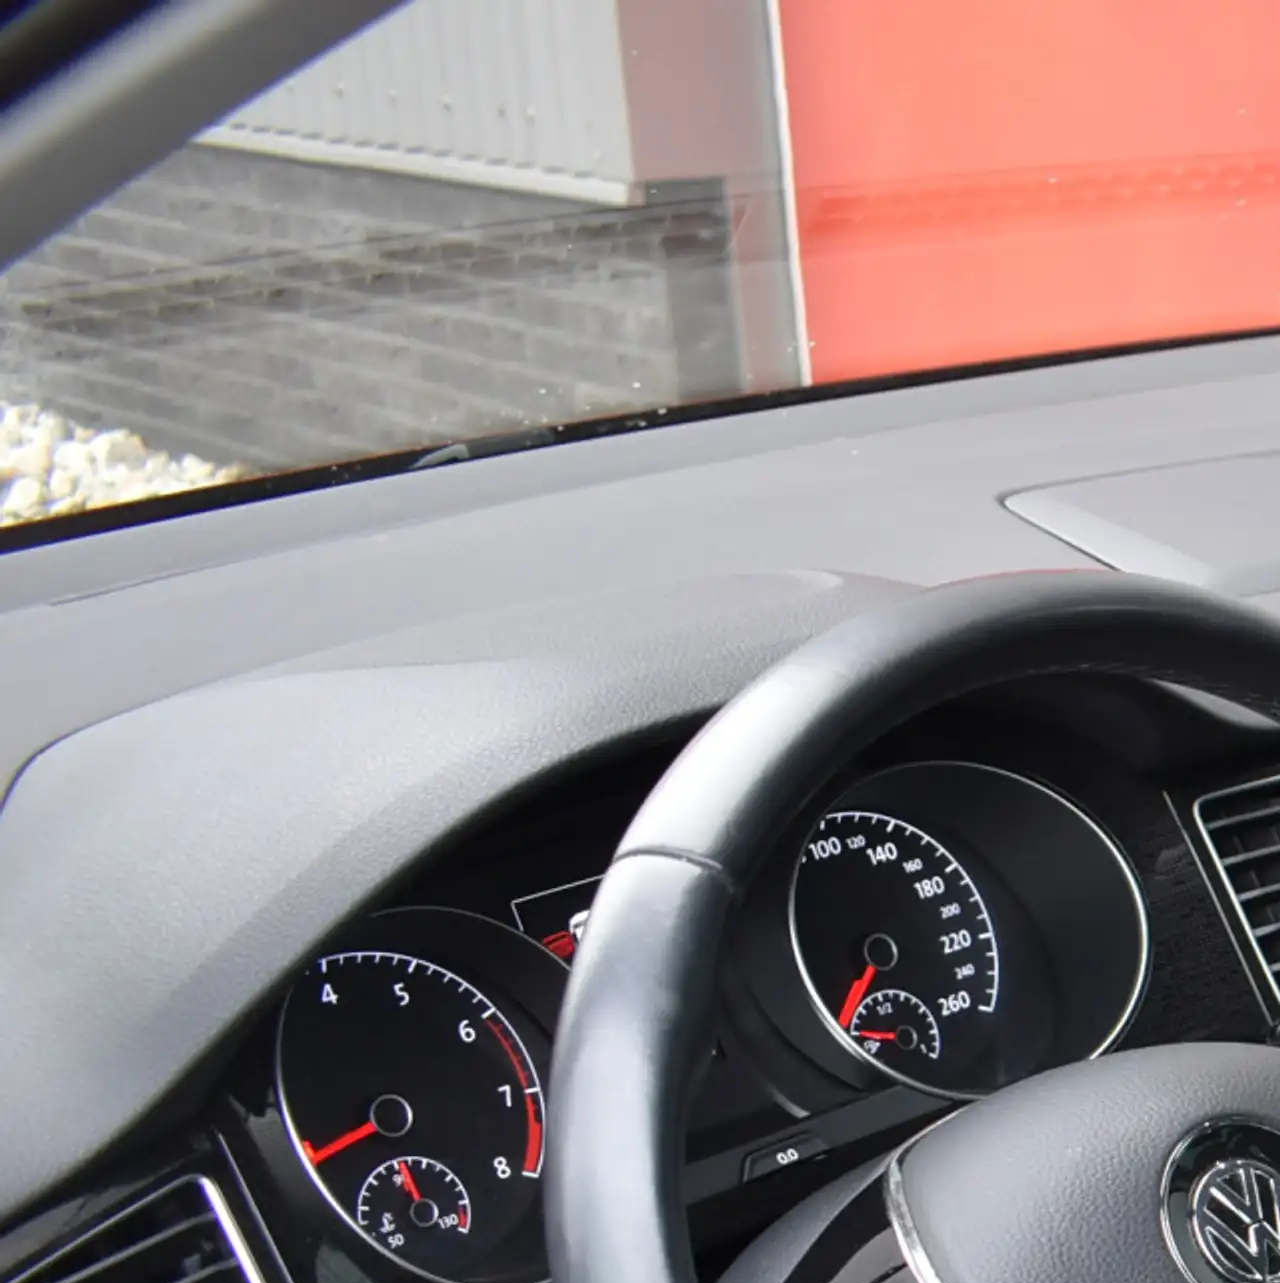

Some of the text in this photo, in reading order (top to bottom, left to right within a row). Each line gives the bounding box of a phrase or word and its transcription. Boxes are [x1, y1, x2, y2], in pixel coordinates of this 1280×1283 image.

[808, 836, 842, 861] 100
[845, 834, 866, 849] 120
[866, 842, 898, 866] 140
[902, 857, 924, 873] 160
[913, 876, 945, 899] 180
[939, 902, 961, 919] 200
[939, 928, 972, 954] 220
[321, 982, 339, 1006] 4
[393, 981, 411, 1006] 5
[937, 990, 971, 1017] 260
[458, 1019, 477, 1043] 6
[497, 1084, 513, 1108] 7
[493, 1156, 512, 1180] 8
